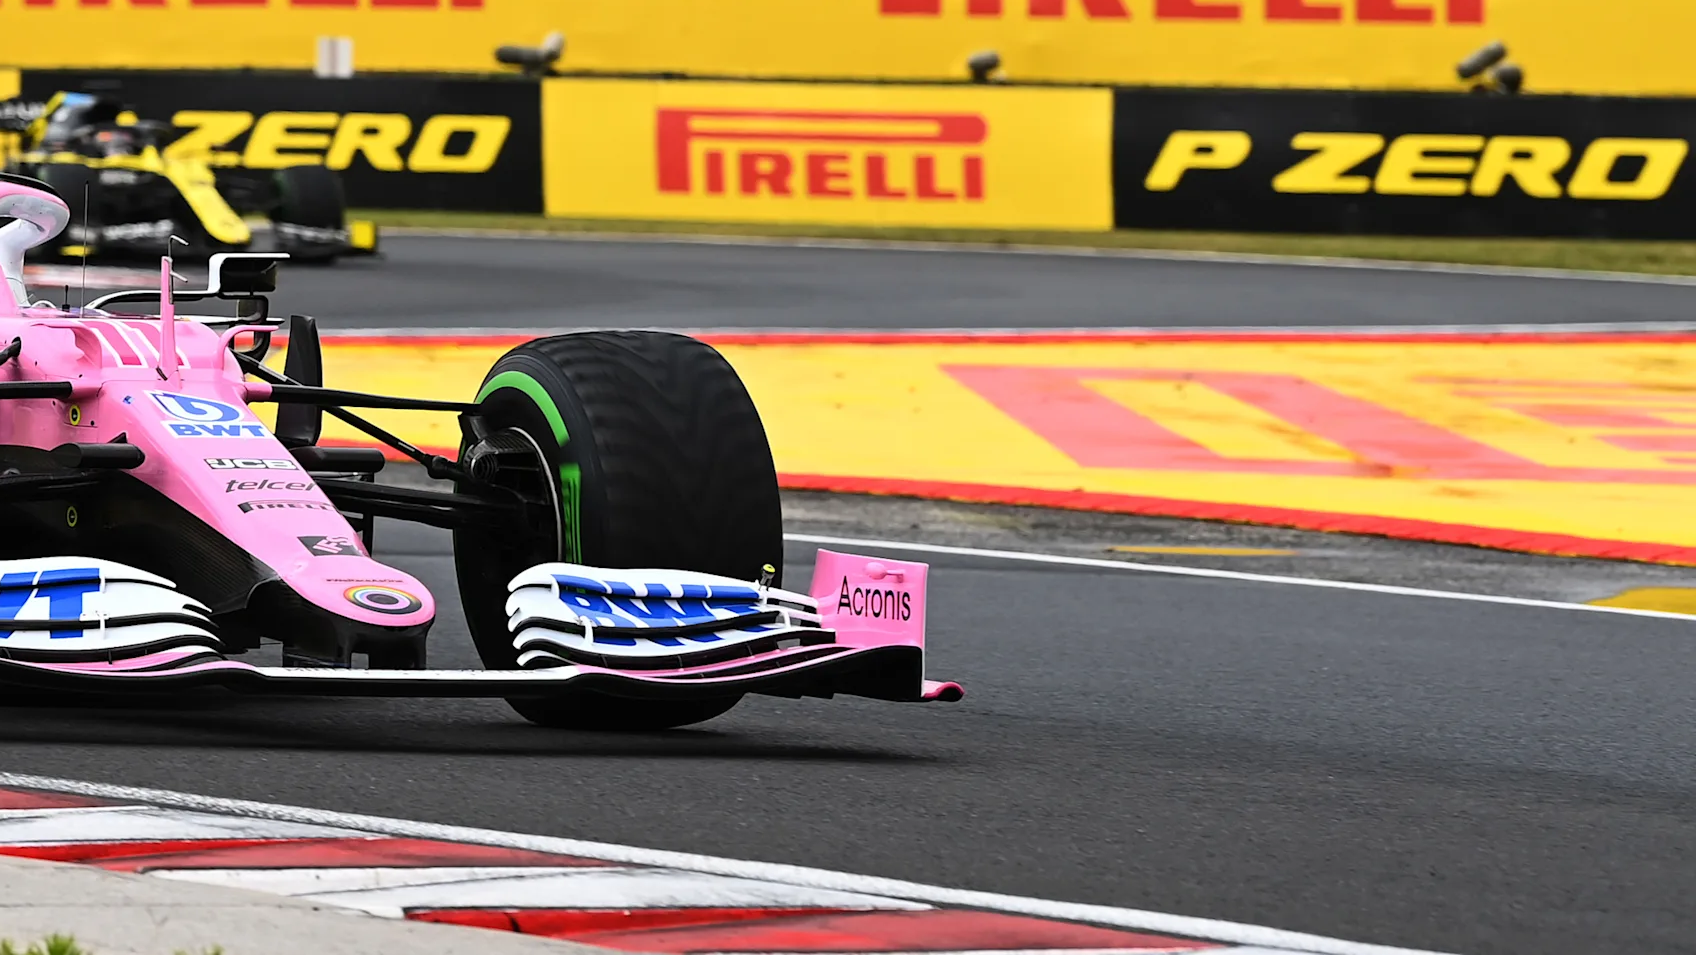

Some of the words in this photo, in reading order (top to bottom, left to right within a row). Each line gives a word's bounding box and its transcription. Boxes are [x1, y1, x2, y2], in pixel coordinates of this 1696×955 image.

[166, 110, 511, 173] ZERO
[655, 108, 988, 201] PIRELLI
[1144, 129, 1252, 192] P
[1271, 131, 1689, 199] ZERO
[171, 424, 266, 437] BWT
[209, 459, 297, 470] JCB
[225, 479, 316, 494] telcel
[551, 574, 780, 646] BWT
[838, 576, 911, 621] Acronis
